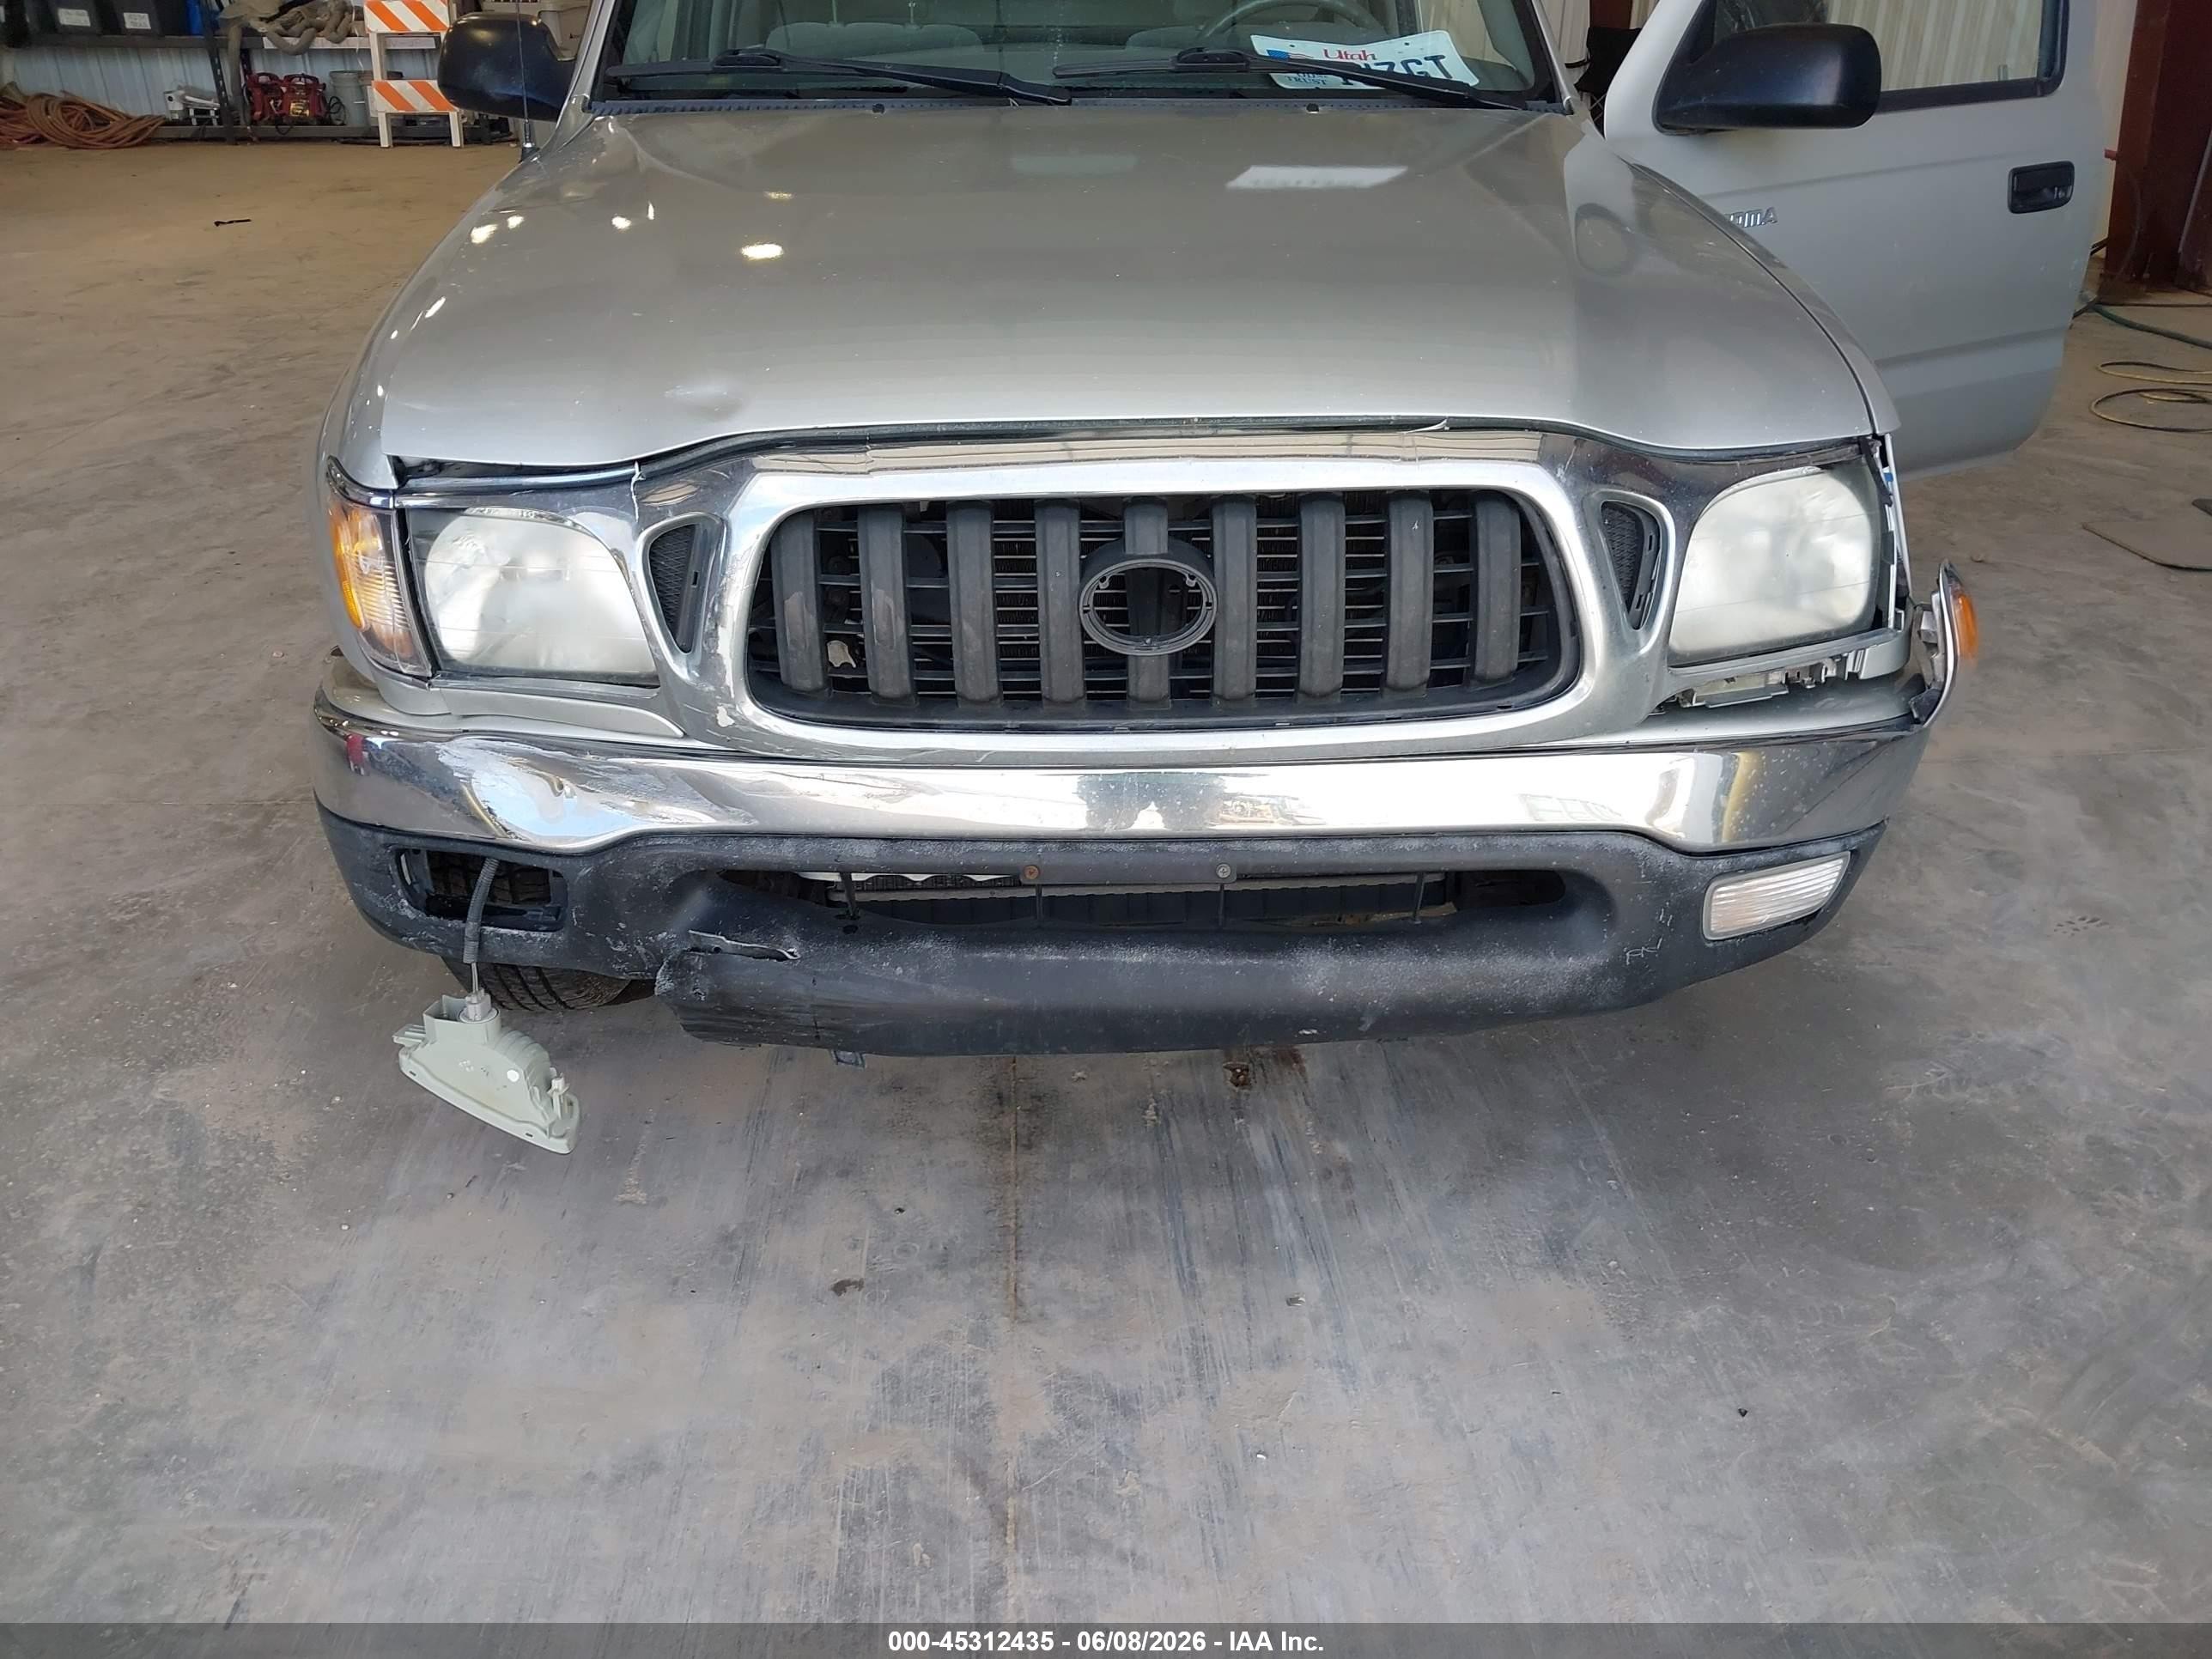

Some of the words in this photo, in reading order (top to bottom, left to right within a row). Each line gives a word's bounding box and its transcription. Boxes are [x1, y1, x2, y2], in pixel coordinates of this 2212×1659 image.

[1323, 49, 1376, 61] Utah
[1285, 76, 1327, 85] TRUST
[1724, 207, 1778, 228] OMA
